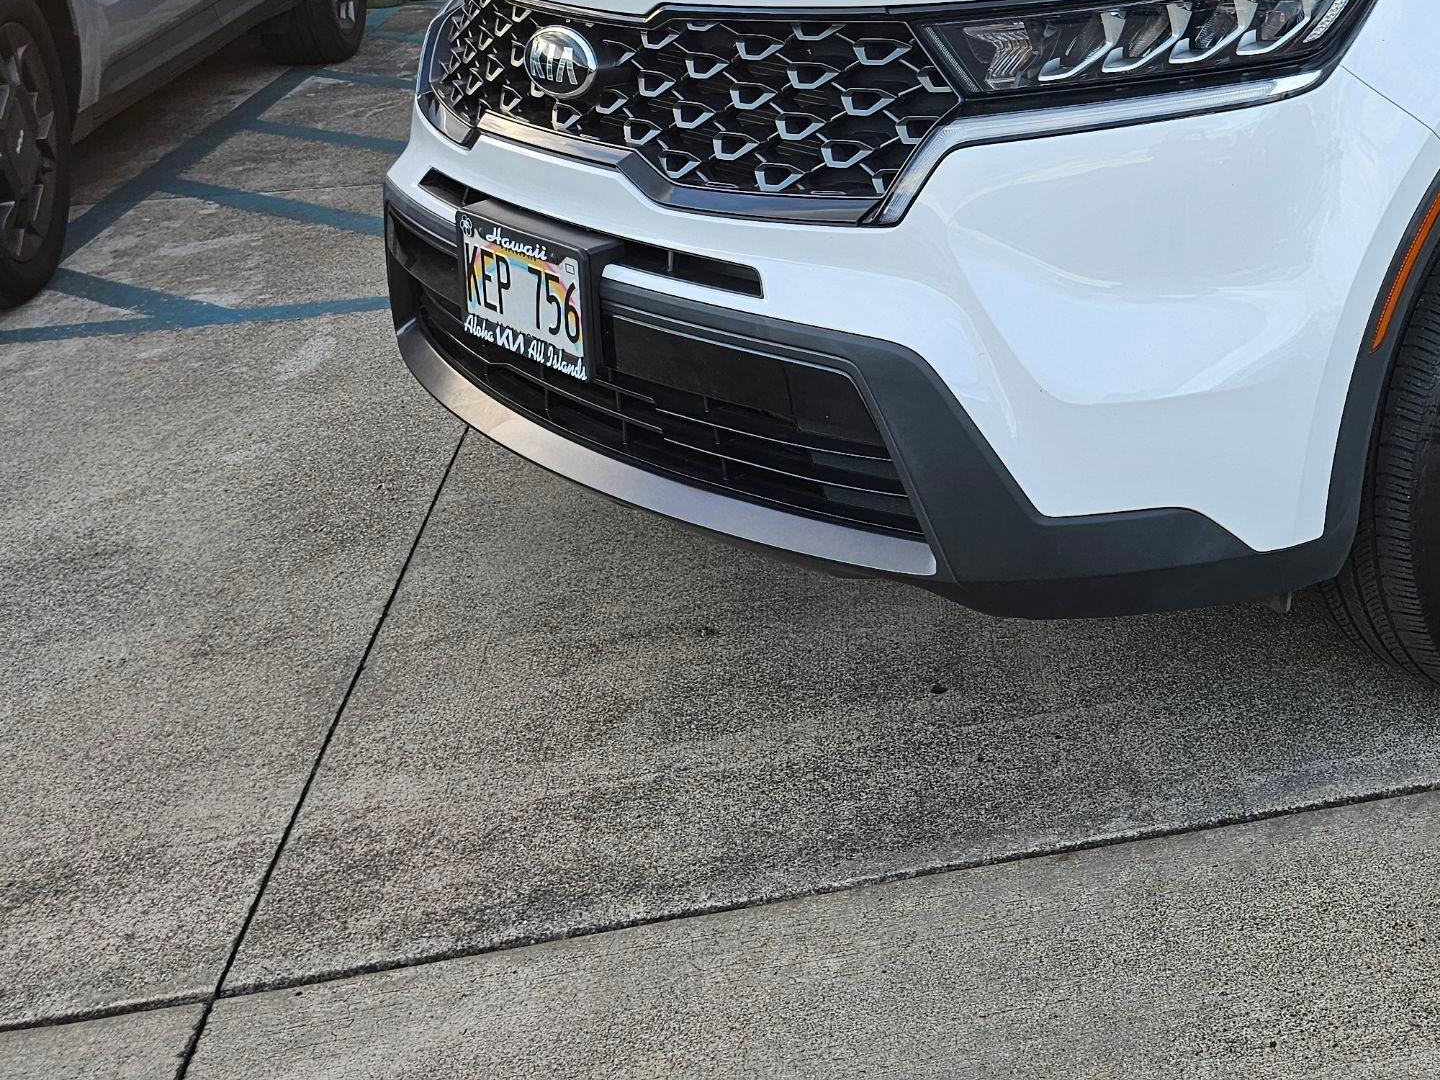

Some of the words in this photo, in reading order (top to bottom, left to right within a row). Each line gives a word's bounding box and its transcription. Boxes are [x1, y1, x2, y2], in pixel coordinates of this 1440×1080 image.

[530, 36, 578, 85] KIA
[485, 227, 548, 261] Hawaii
[465, 242, 511, 315] KEP
[528, 265, 580, 344] 756
[464, 314, 495, 342] Aloha
[528, 339, 545, 364] All
[547, 345, 588, 381] Islands
